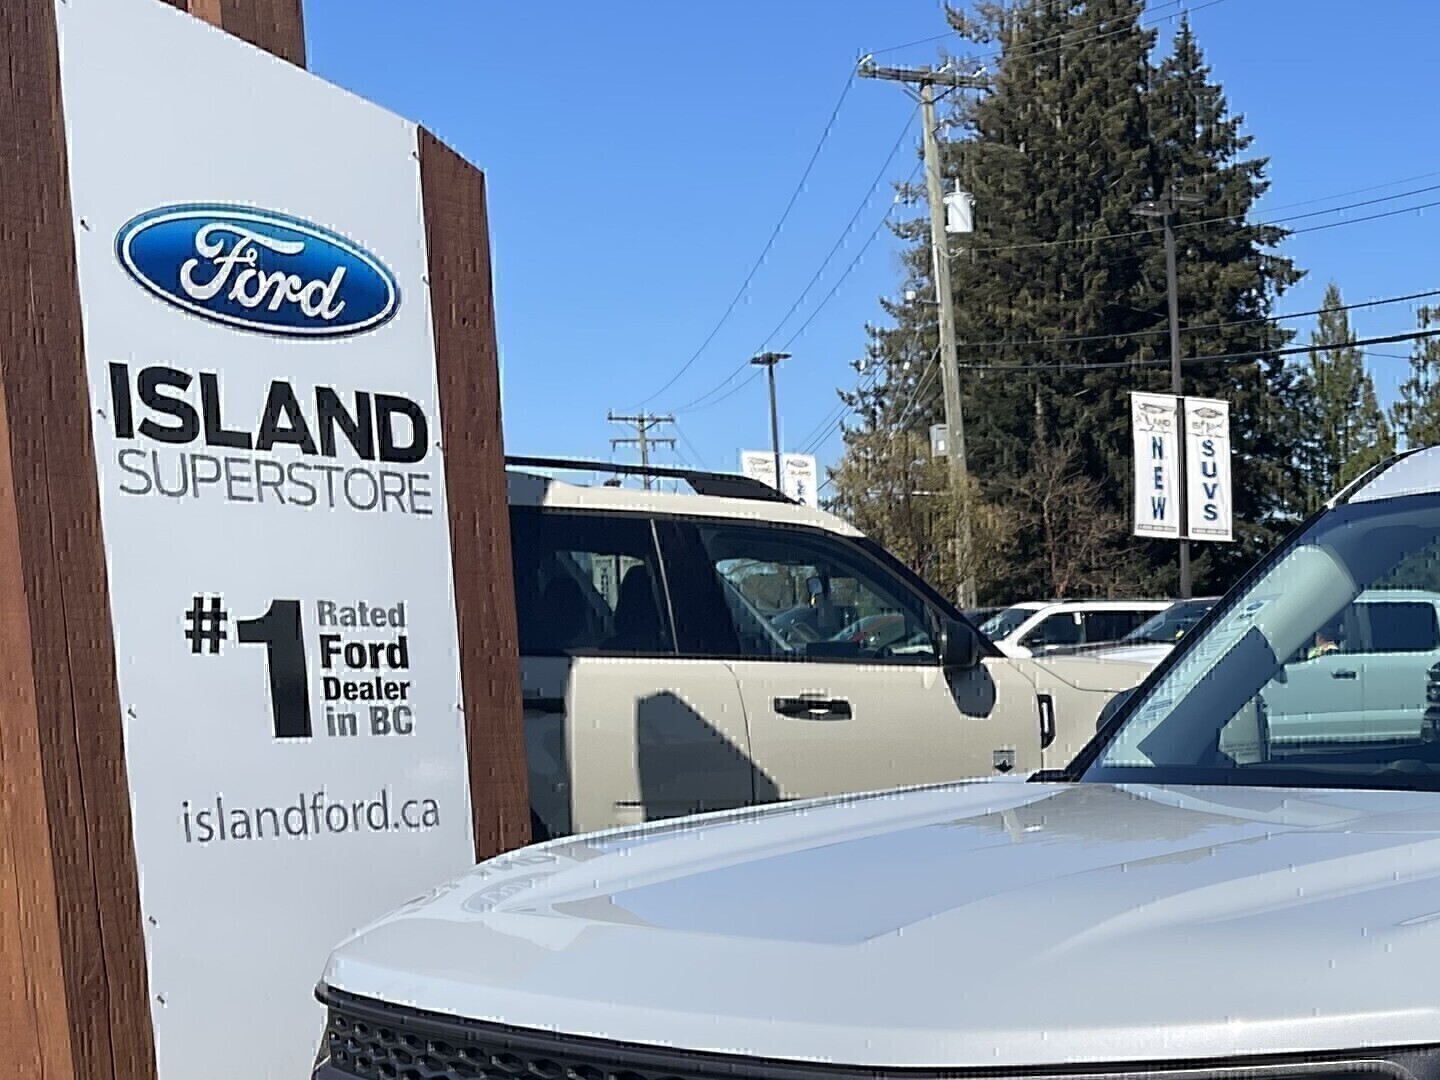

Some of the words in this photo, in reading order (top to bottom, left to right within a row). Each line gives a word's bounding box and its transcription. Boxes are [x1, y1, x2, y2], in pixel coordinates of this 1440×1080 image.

[180, 221, 347, 321] Ford
[109, 361, 429, 463] ISLAND
[118, 449, 433, 515] SUPERSTORE
[1151, 435, 1167, 521] NEW
[317, 600, 405, 628] Rated
[319, 634, 409, 669] Ford
[323, 676, 410, 701] Dealer
[326, 706, 357, 736] in
[369, 705, 412, 736] BC
[182, 788, 441, 843] islandford.ca
